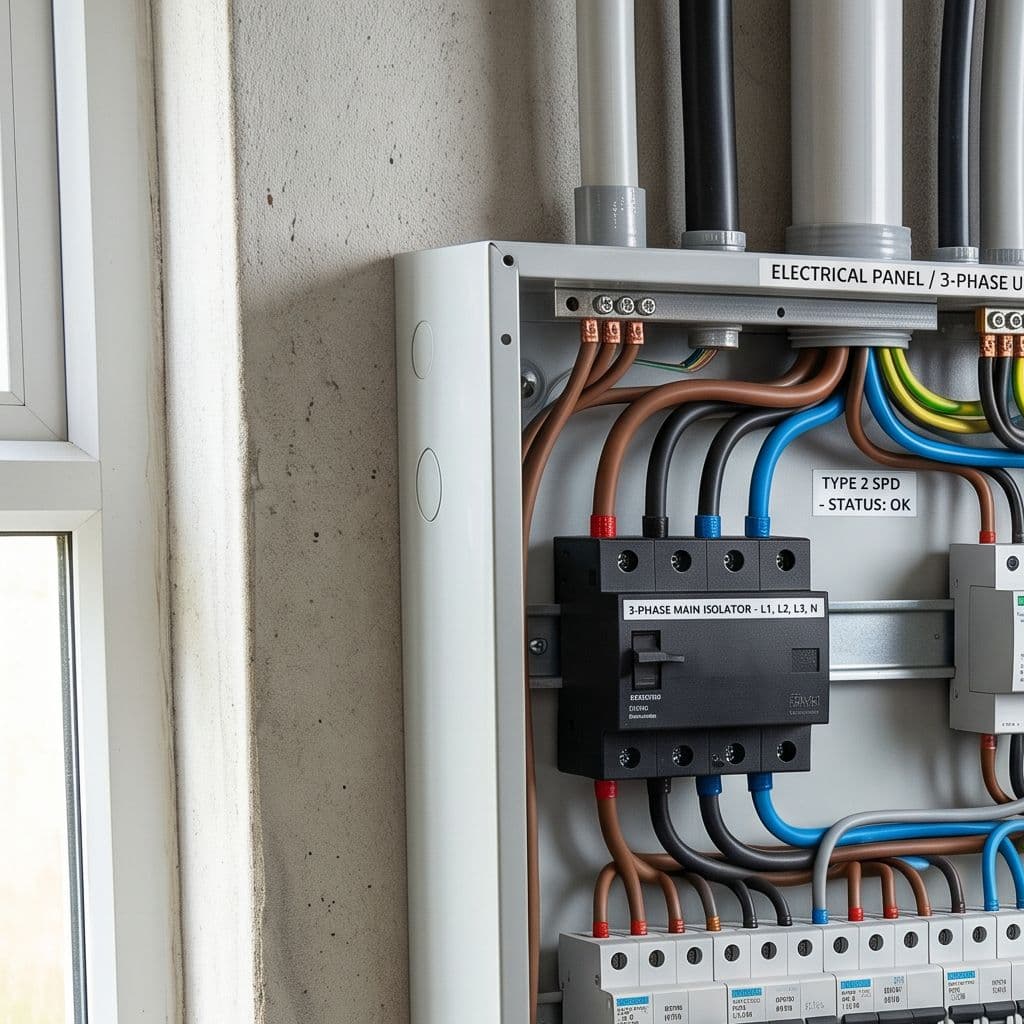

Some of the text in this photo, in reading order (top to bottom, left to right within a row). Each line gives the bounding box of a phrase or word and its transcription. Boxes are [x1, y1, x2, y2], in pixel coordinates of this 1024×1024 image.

[771, 263, 868, 284] ELECTRICAL
[872, 268, 925, 287] PANEL
[928, 269, 936, 290] /
[940, 272, 1009, 291] 3-PHASE
[821, 476, 901, 491] TYPE 2 SPD
[828, 497, 887, 511] STATUS:
[890, 498, 911, 512] OK
[628, 605, 671, 615] 3-PHASE
[673, 604, 701, 615] MAIN
[703, 604, 752, 614] ISOLATOR
[760, 604, 775, 615] L1,
[777, 604, 791, 615] L2,
[793, 603, 808, 615] L3,
[810, 603, 818, 613] N
